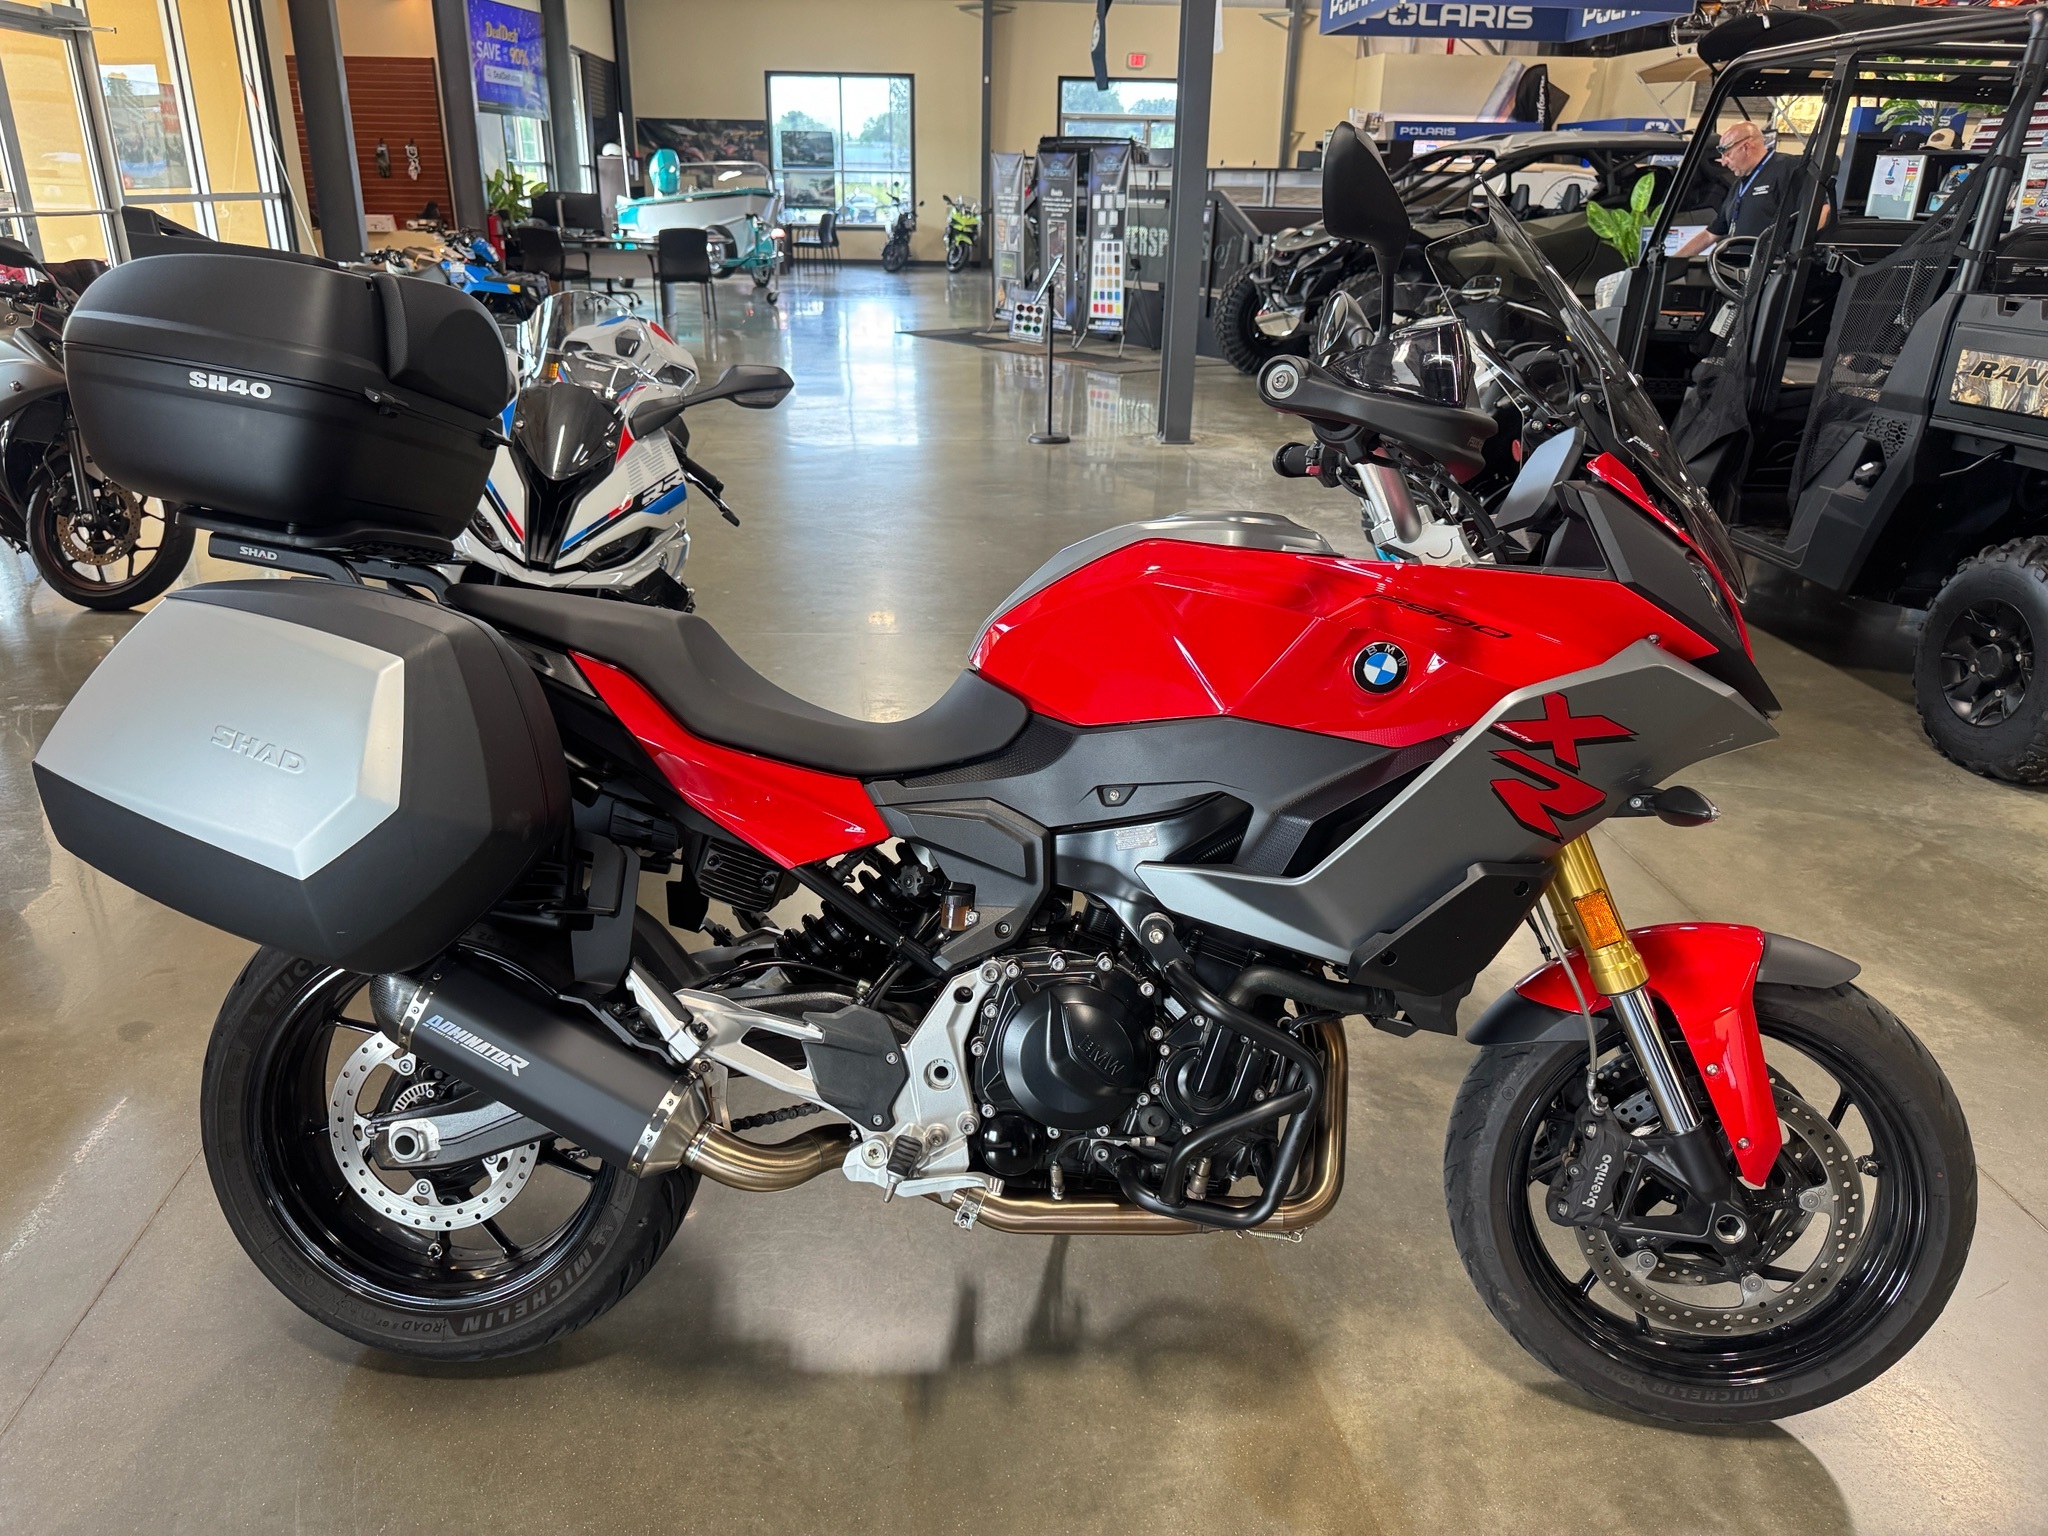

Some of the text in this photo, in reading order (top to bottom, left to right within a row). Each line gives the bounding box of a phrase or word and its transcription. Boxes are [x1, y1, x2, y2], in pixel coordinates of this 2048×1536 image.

[475, 40, 501, 62] SAVE
[1399, 126, 1457, 136] POLARIS
[188, 370, 272, 399] SH40
[239, 545, 278, 561] SHAD
[1364, 643, 1409, 668] BMW
[210, 724, 307, 775] SHAD
[1581, 1153, 1613, 1209] brembo
[460, 1248, 594, 1334] MICHELIN
[401, 1319, 443, 1334] ROAD
[1651, 1381, 1760, 1402] MICHELIN
